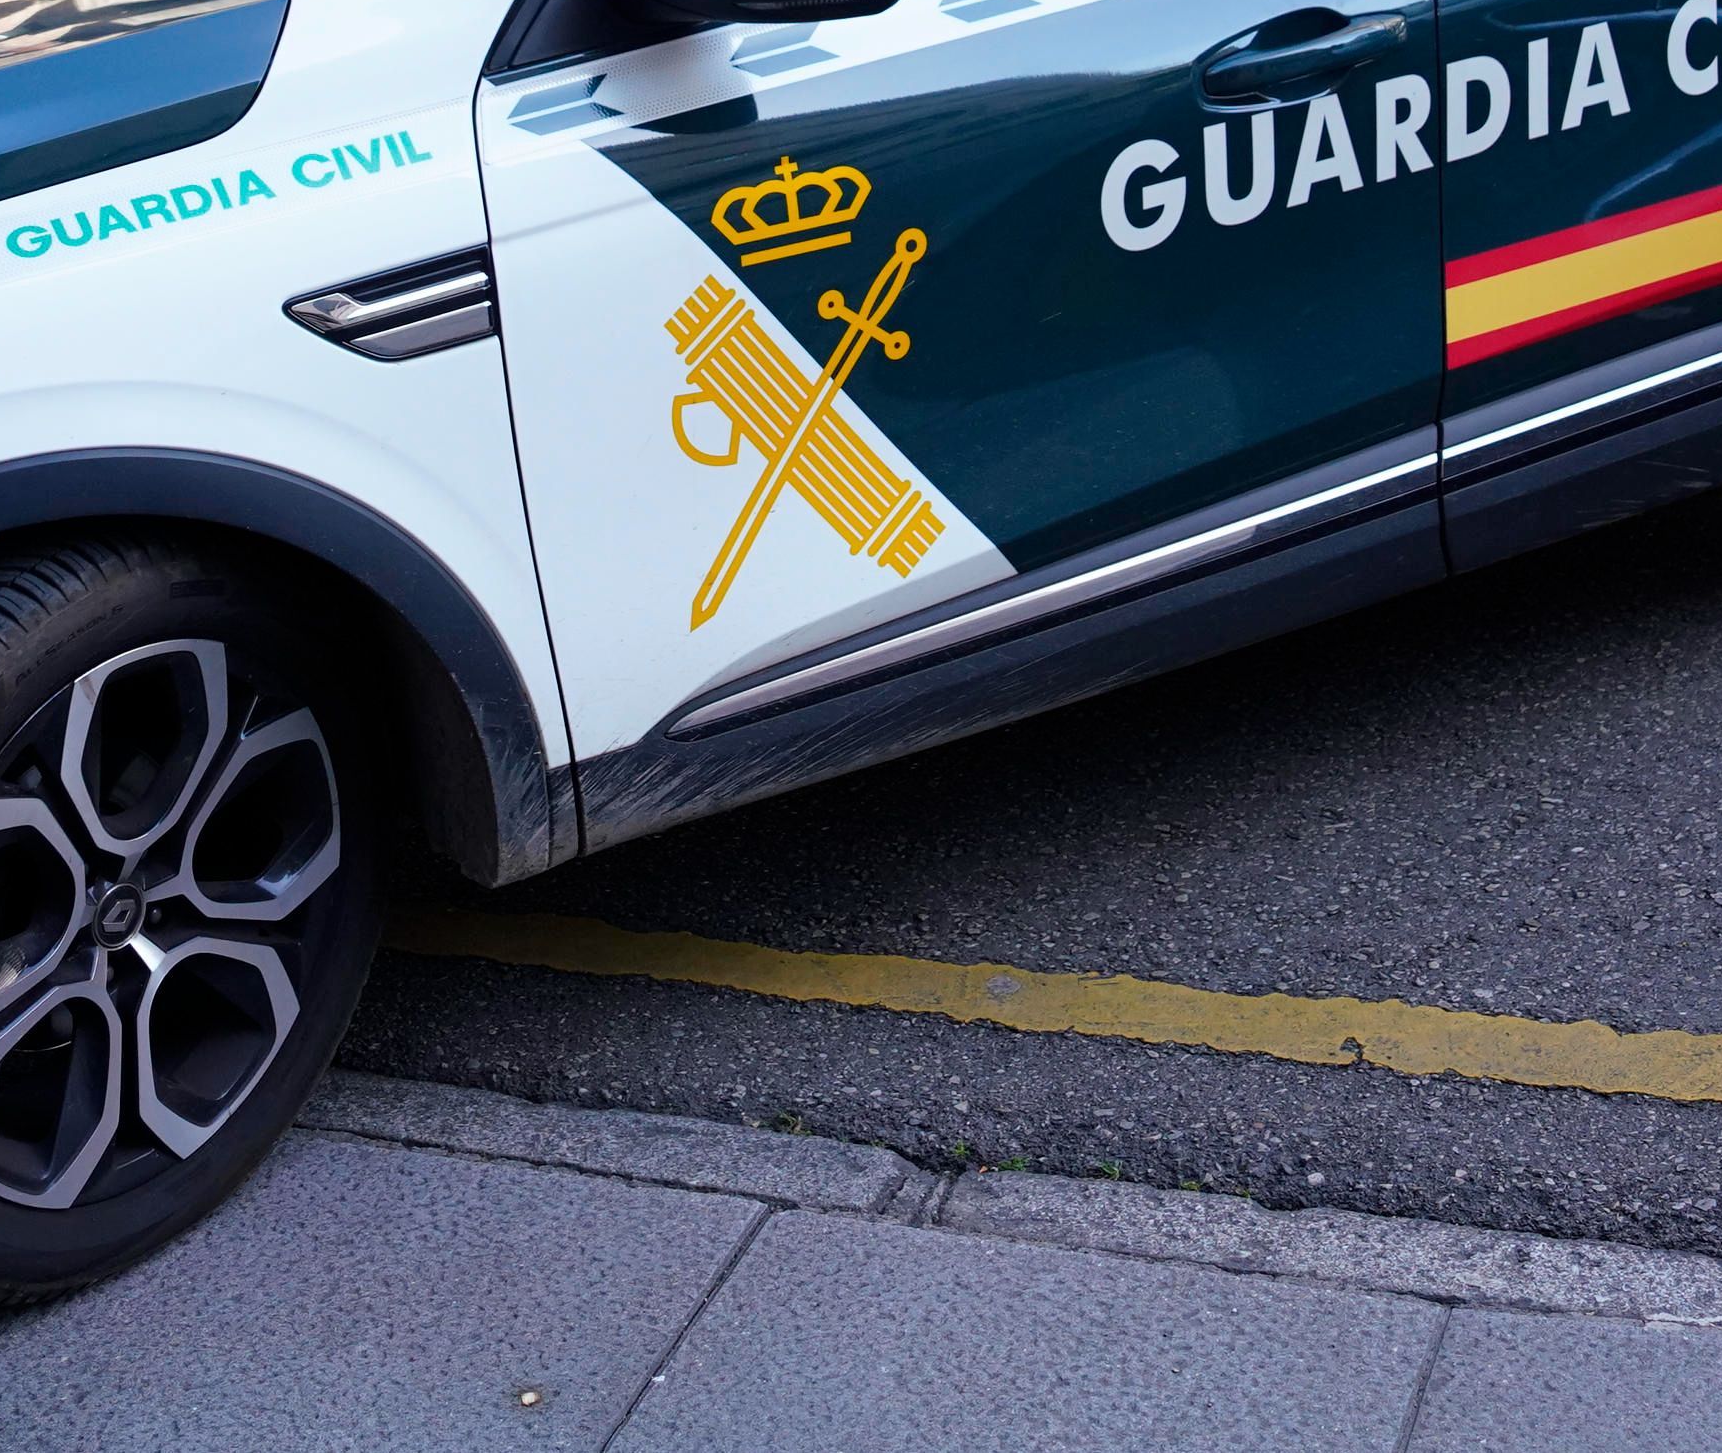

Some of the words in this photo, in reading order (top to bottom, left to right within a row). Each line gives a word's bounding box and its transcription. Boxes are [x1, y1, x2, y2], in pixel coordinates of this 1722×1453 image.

[5, 169, 277, 259] GUARDIA
[291, 130, 433, 189] CIVIL
[1101, 21, 1631, 252] GUARDIA
